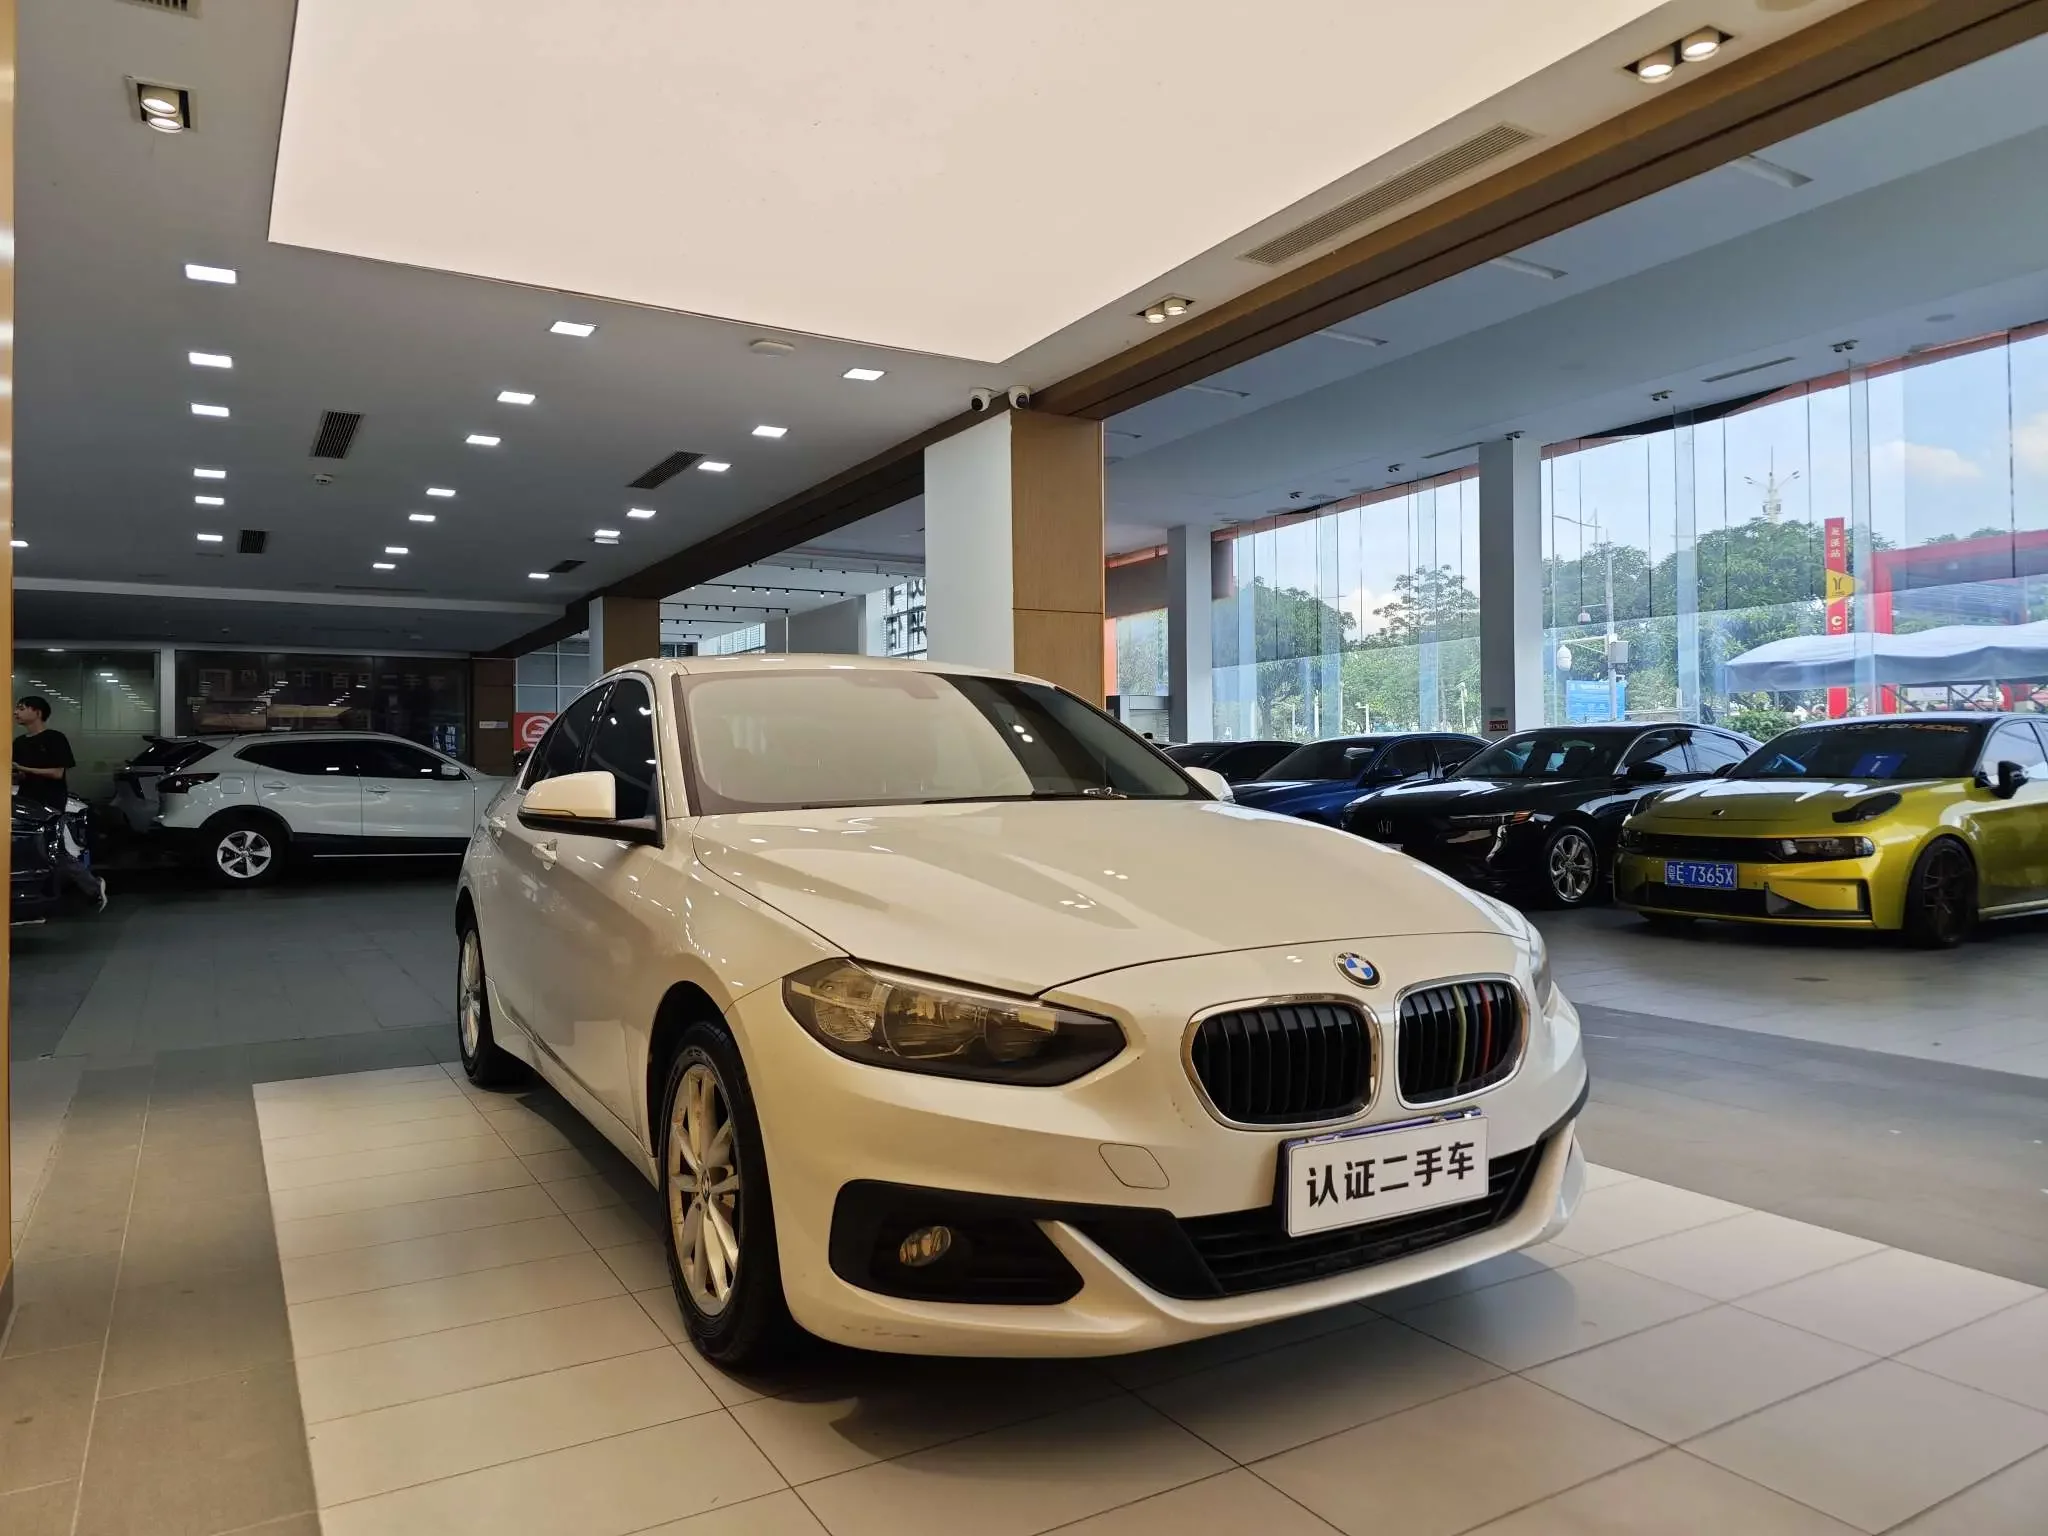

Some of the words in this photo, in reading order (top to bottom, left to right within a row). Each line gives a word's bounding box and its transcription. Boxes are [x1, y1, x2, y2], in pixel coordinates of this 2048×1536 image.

[1306, 1141, 1475, 1208] 认证二手车
